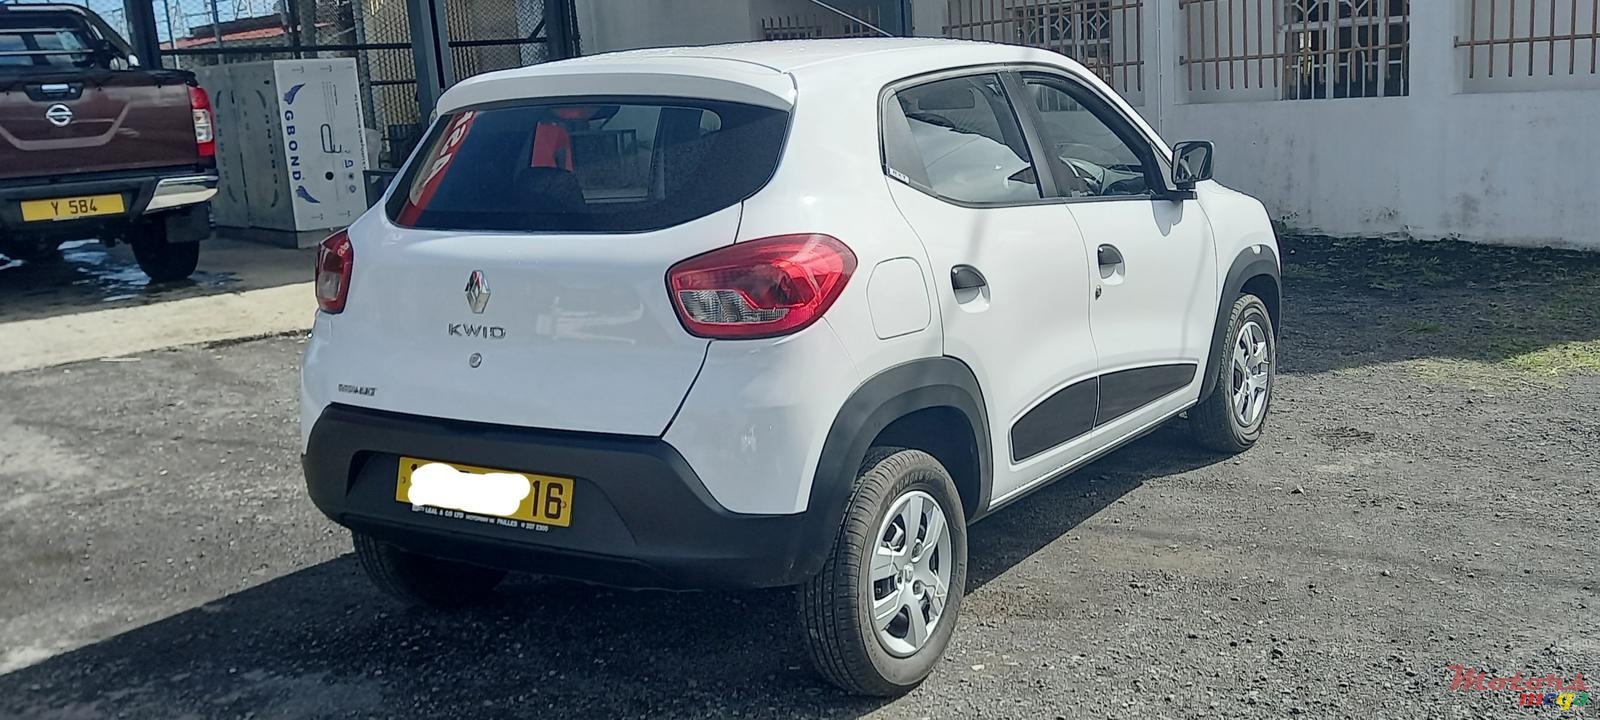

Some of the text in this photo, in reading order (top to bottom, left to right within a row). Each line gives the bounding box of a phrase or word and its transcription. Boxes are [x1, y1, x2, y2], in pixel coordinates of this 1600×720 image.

[51, 198, 98, 216] Y 584
[448, 323, 506, 339] KWID
[532, 480, 563, 520] 16
